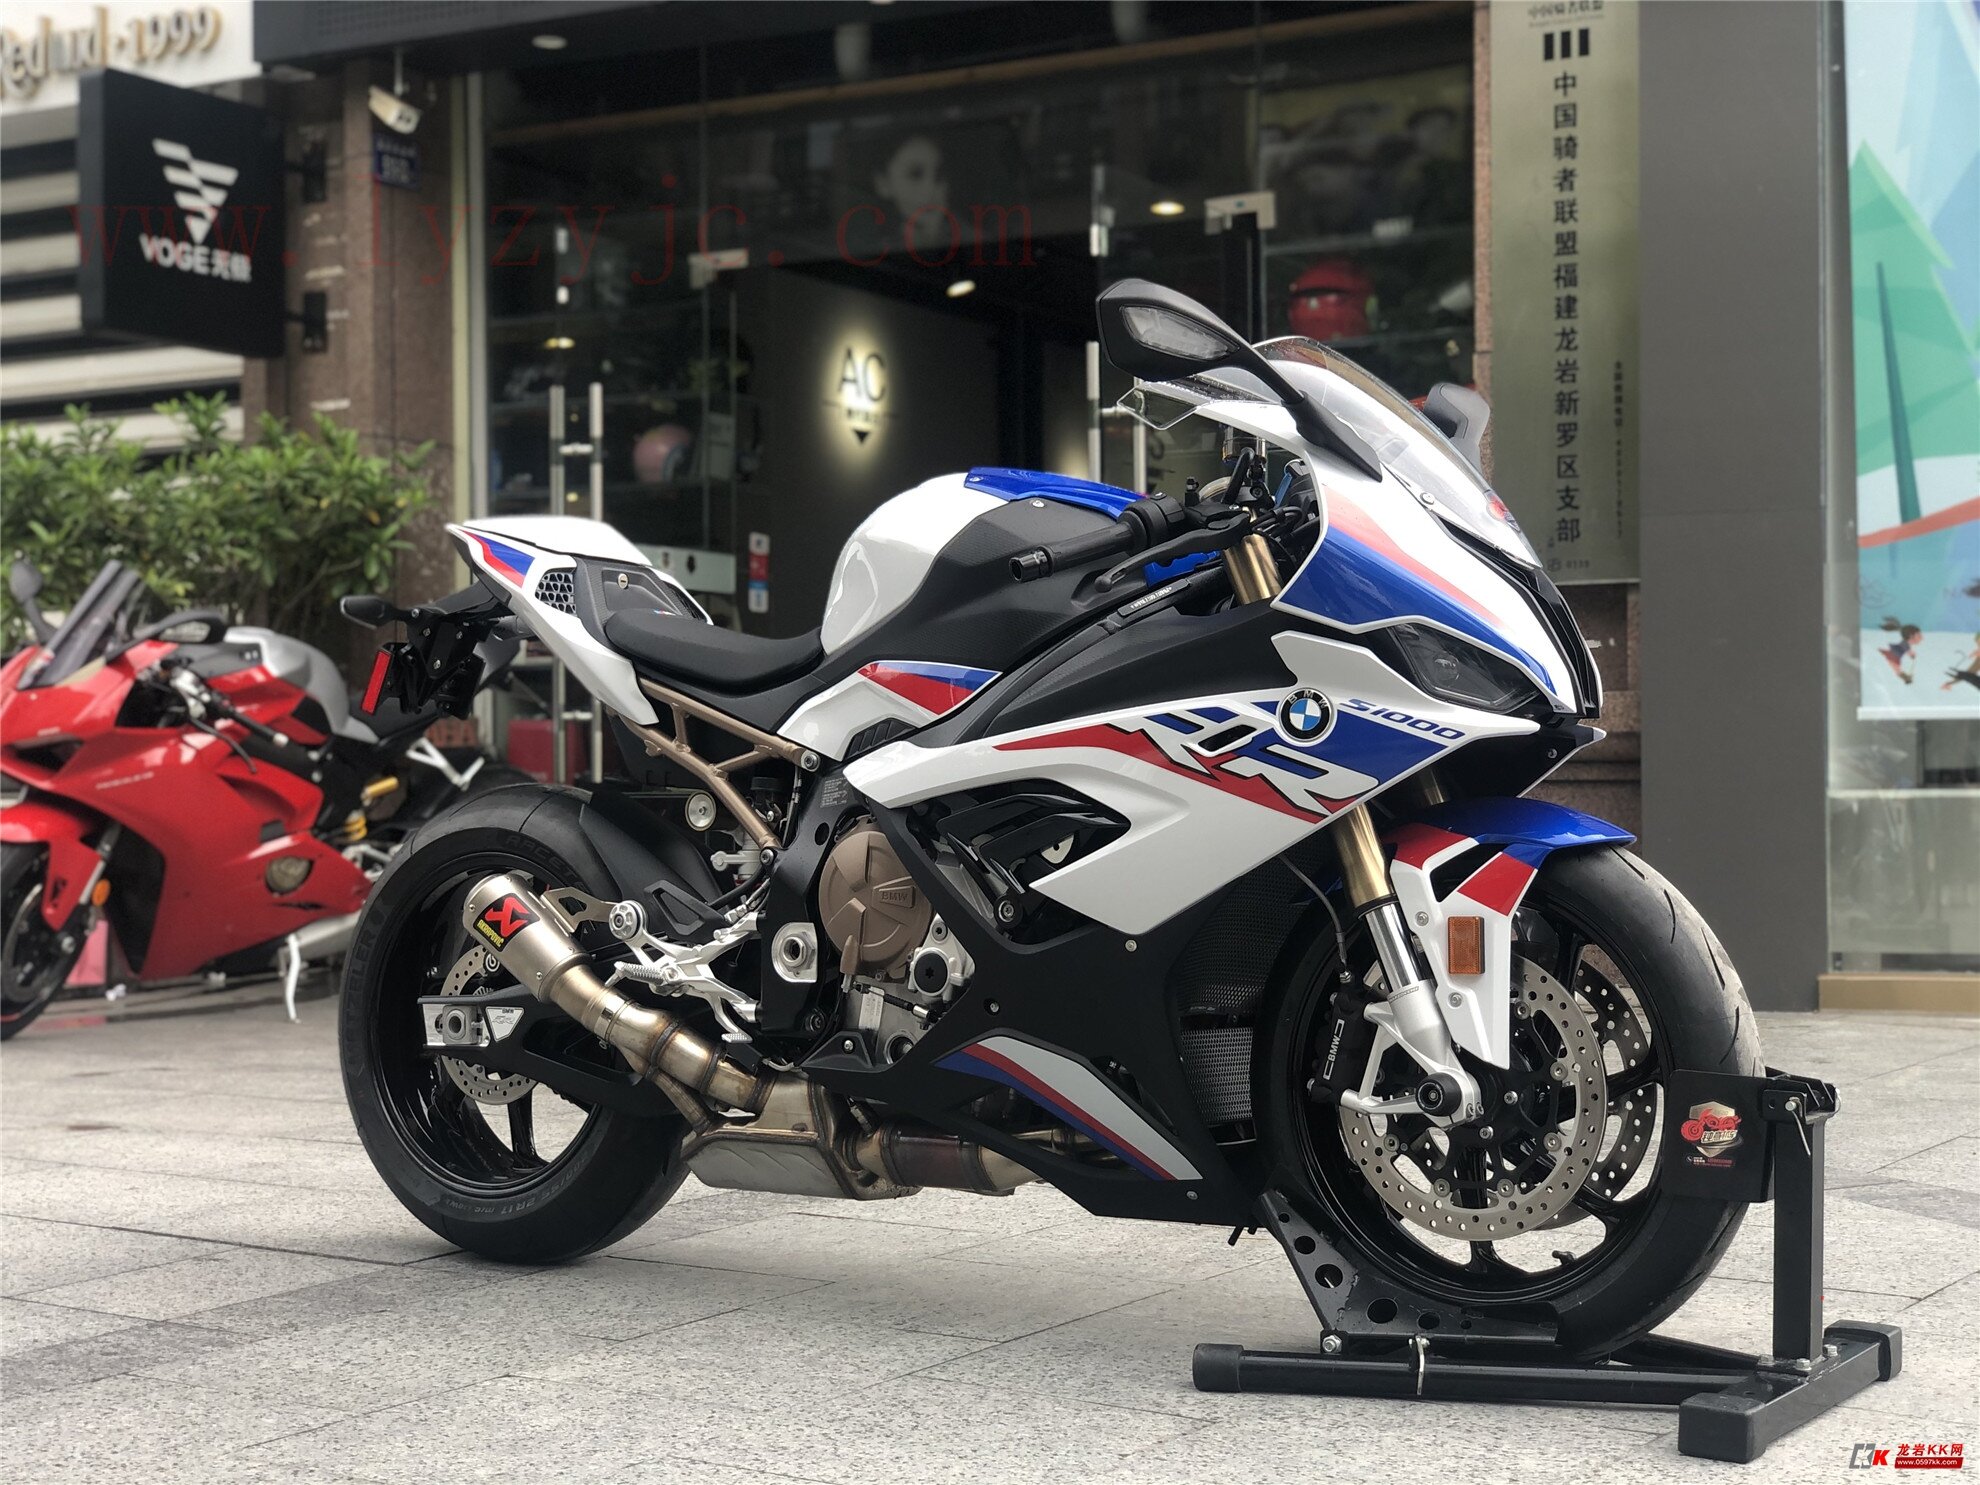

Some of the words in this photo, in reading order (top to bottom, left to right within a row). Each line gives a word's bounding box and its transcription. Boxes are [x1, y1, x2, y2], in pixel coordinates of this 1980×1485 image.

[139, 232, 210, 275] VOGE
[1553, 71, 1581, 542] 中国骑者联盟福建龙岩新罗区支部
[838, 347, 886, 402] AC
[1340, 698, 1466, 740] S1000
[881, 891, 909, 902] BMW
[1327, 1034, 1341, 1062] BMW
